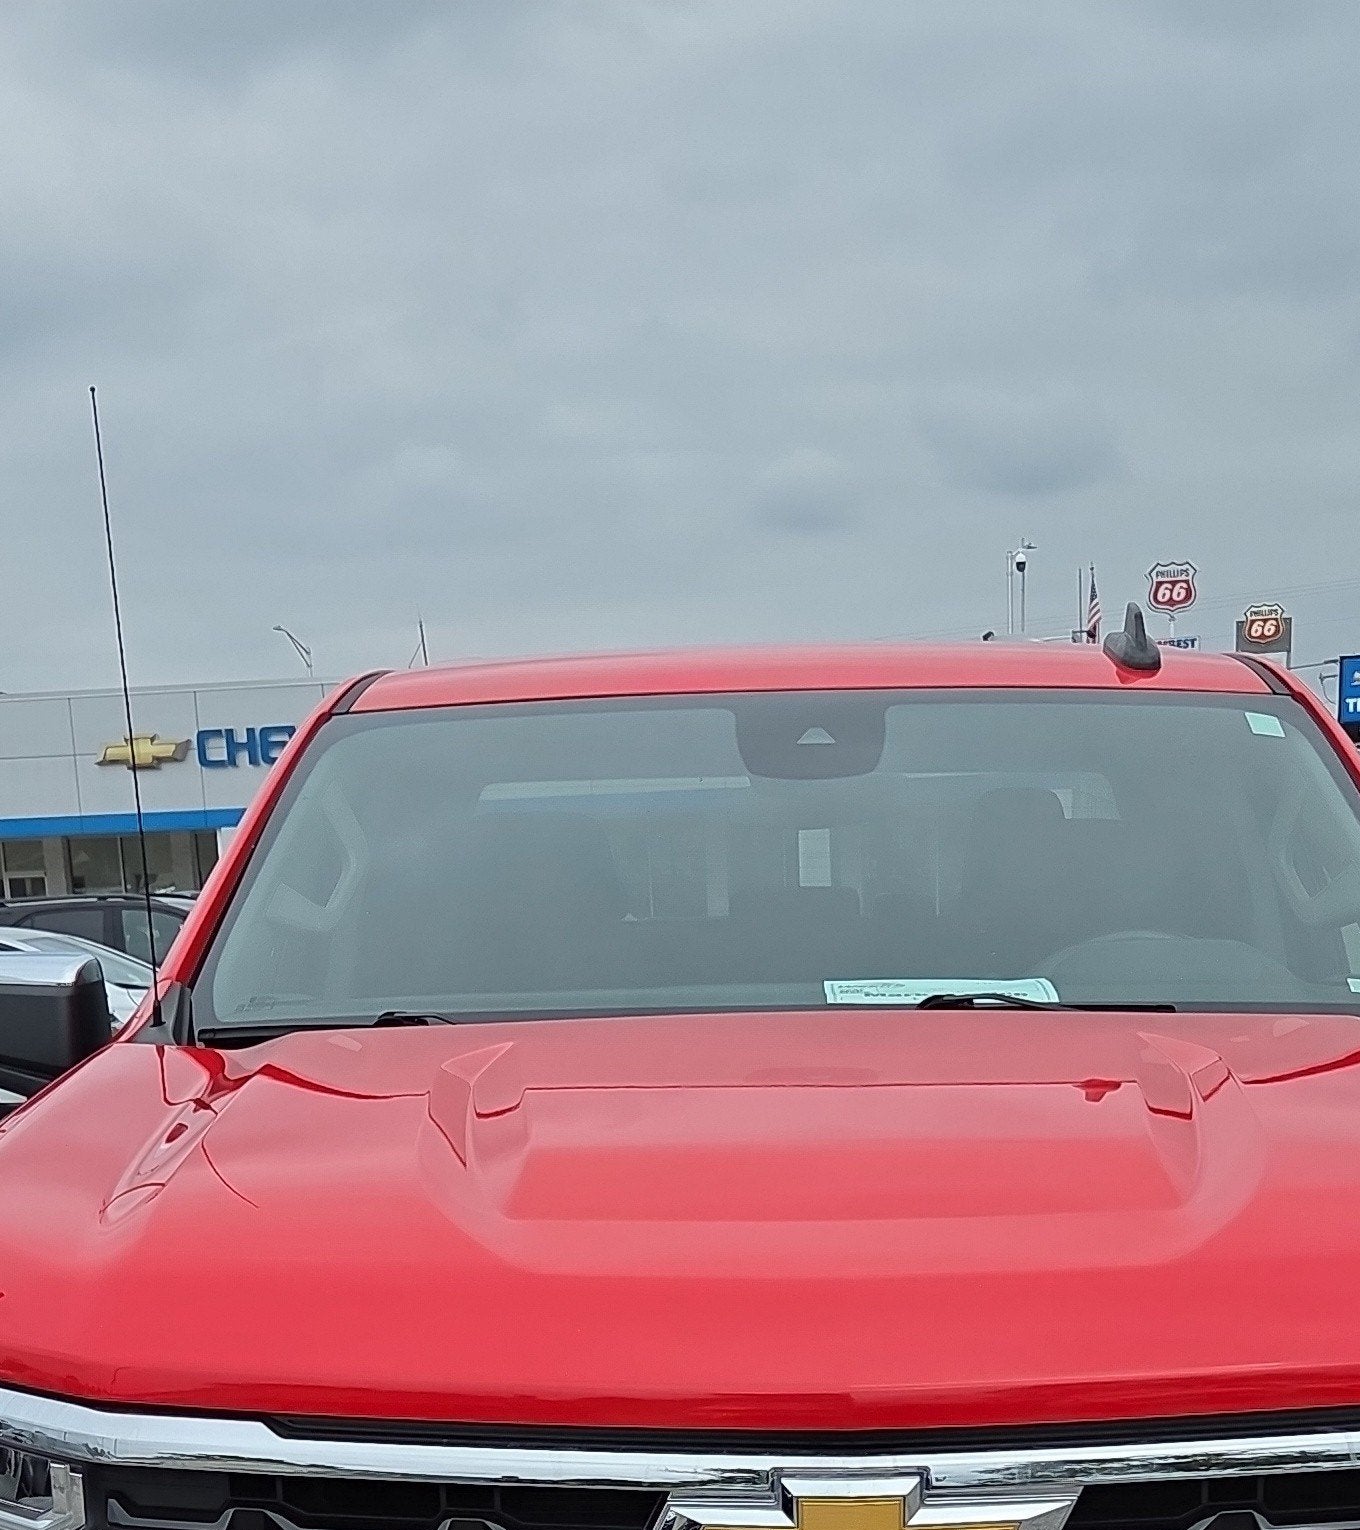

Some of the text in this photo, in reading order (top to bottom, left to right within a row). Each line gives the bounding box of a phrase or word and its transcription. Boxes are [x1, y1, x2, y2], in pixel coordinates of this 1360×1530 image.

[1155, 567, 1191, 579] PHILLIPS
[1156, 582, 1188, 603] 66
[1249, 608, 1279, 618] PHILLIPS
[1250, 619, 1278, 638] 66
